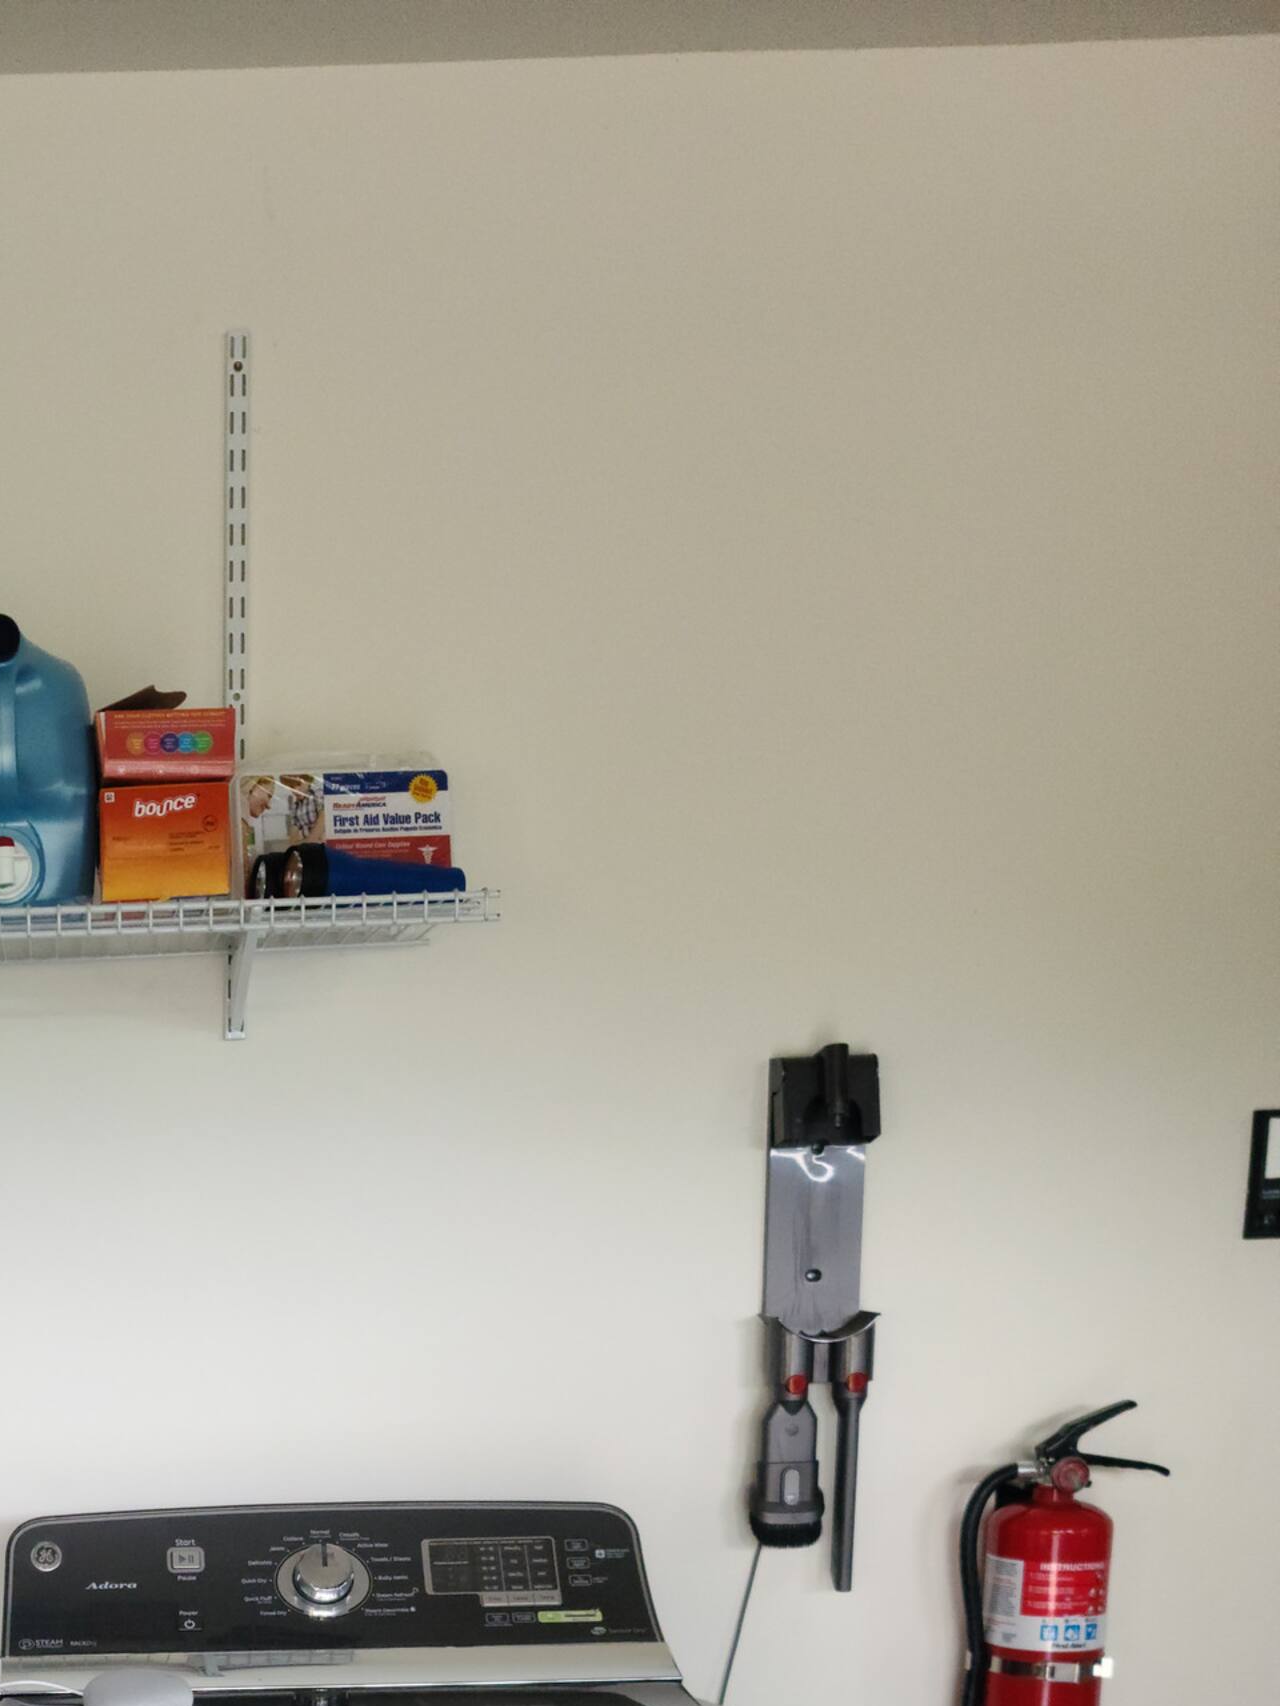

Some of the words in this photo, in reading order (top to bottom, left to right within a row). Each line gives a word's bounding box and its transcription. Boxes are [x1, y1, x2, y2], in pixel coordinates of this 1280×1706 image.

[134, 795, 197, 817] bounce
[333, 815, 359, 827] First
[363, 813, 380, 825] Aid
[382, 813, 411, 825] Value
[414, 811, 441, 824] Pack
[175, 1538, 196, 1546] Start
[85, 1581, 138, 1590] Adora
